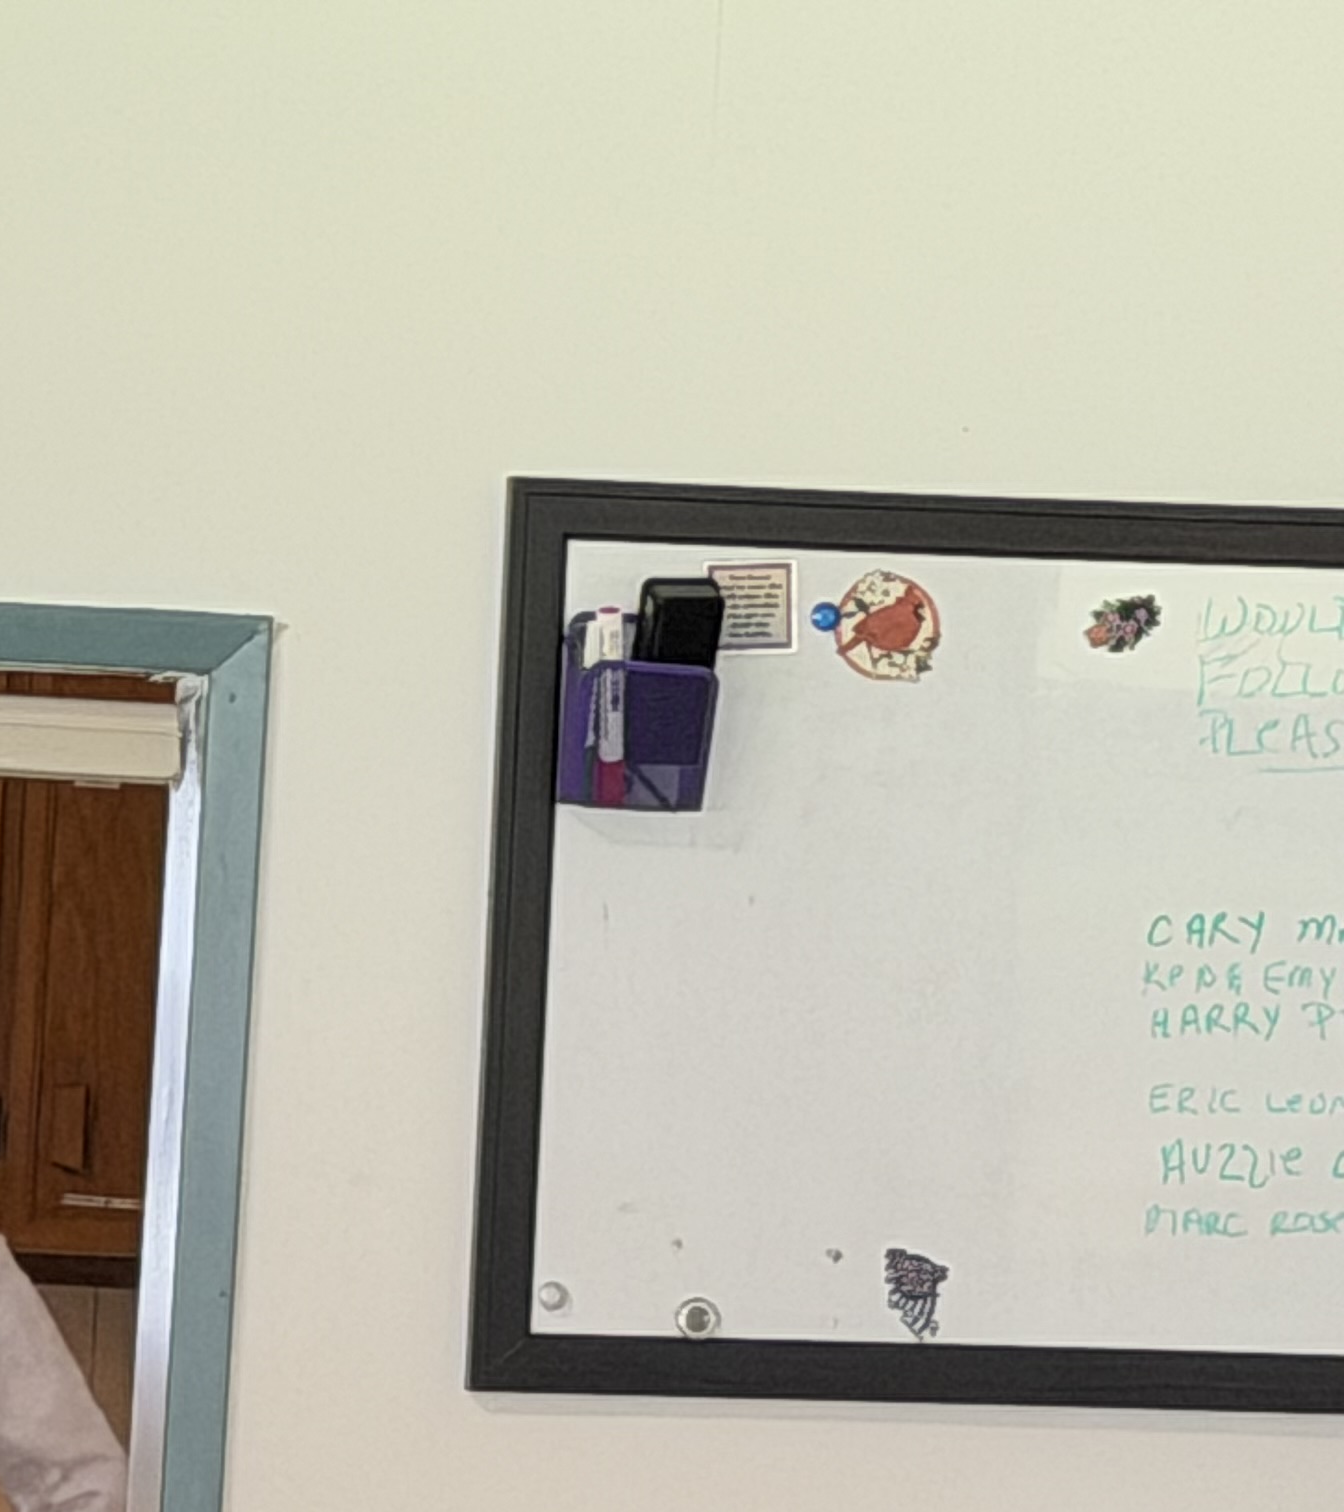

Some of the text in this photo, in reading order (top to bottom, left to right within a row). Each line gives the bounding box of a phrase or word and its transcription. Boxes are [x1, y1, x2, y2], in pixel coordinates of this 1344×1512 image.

[1146, 910, 1266, 955] CARY
[1150, 1001, 1281, 1042] HARRY
[1148, 1082, 1242, 1116] ERIC
